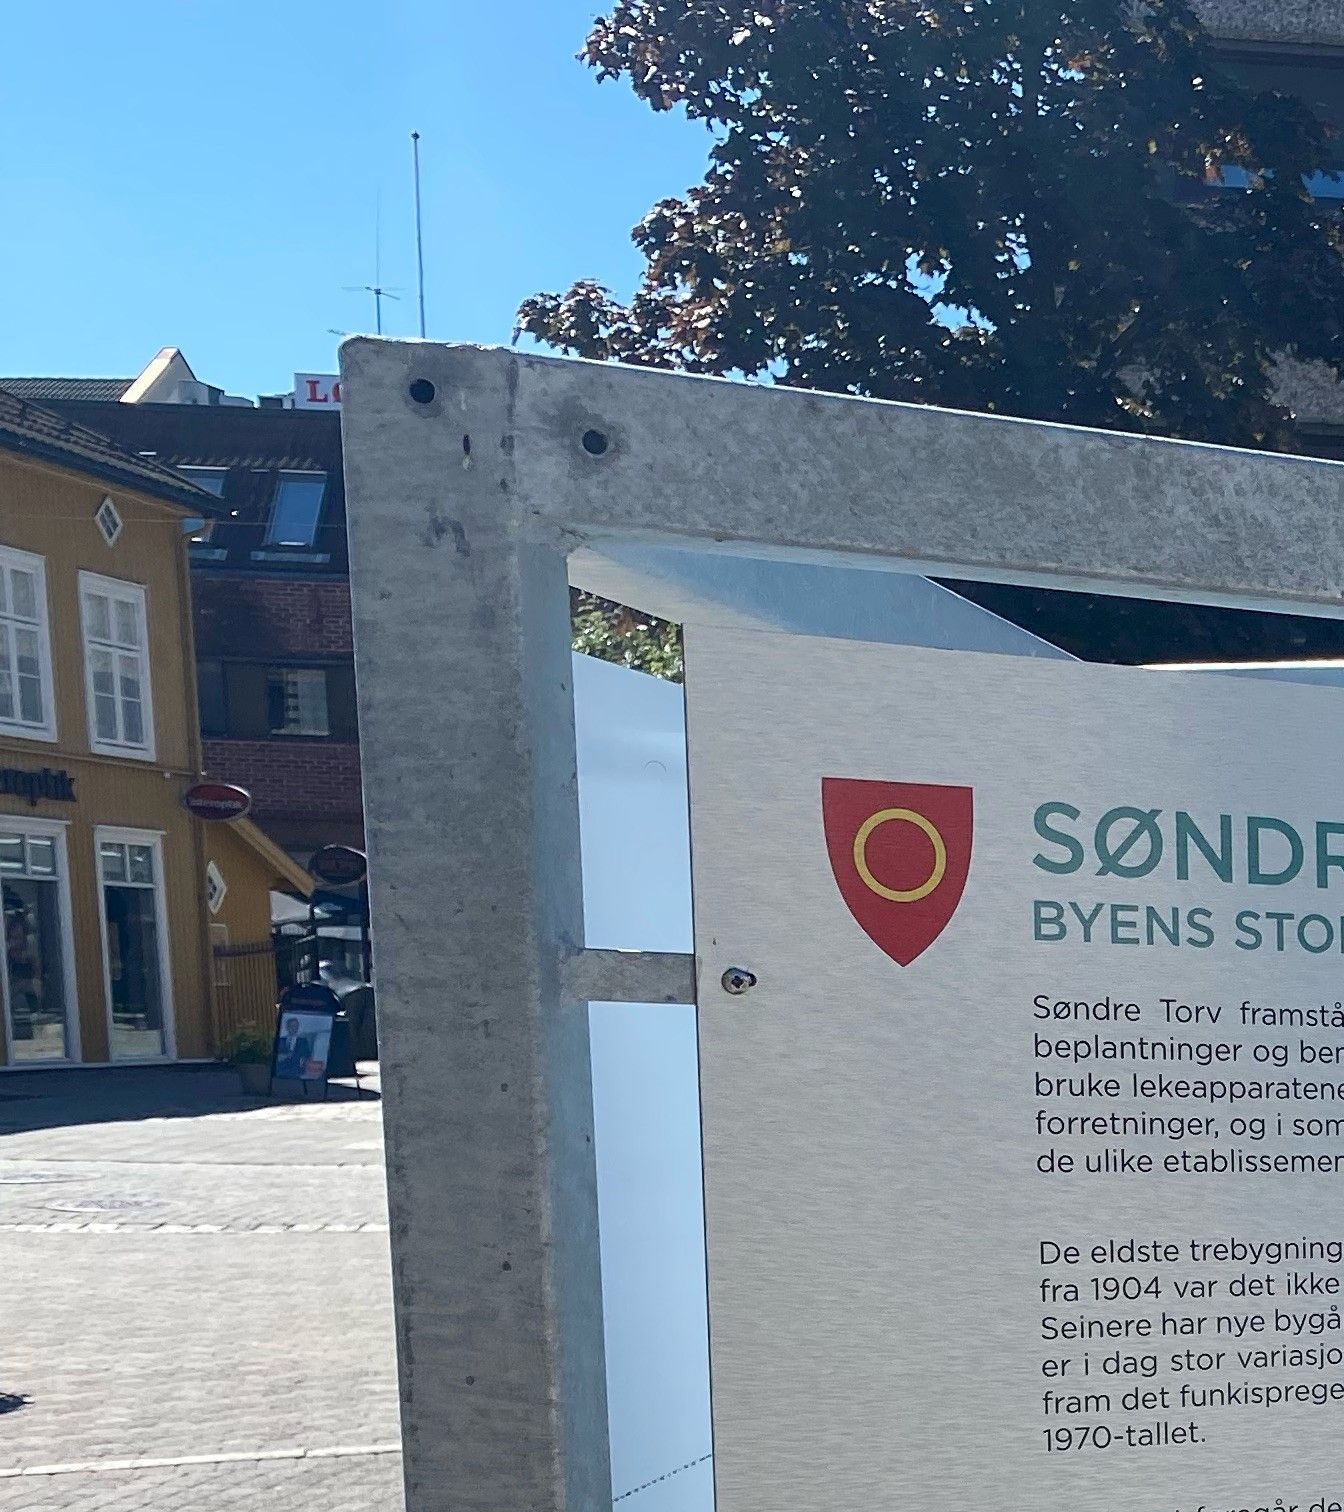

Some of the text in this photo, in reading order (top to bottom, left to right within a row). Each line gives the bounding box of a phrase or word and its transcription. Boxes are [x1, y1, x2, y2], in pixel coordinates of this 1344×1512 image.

[1034, 899, 1216, 949] BYENS
[1033, 994, 1141, 1022] Søndre
[1158, 998, 1222, 1024] Torv
[1034, 1032, 1243, 1066] beplantninger
[1252, 1044, 1289, 1068] og
[1035, 1071, 1121, 1098] bruke
[1034, 1109, 1219, 1141] forretninger,
[1229, 1117, 1266, 1141] og
[1277, 1112, 1282, 1136] i
[1036, 1148, 1075, 1174] de
[1085, 1148, 1153, 1174] ulike
[1039, 1240, 1081, 1265] De
[1090, 1238, 1180, 1264] eldste
[1039, 1277, 1079, 1303] fra
[1090, 1275, 1163, 1301] 1904
[1173, 1279, 1219, 1299] var
[1228, 1272, 1276, 1297] det
[1286, 1271, 1340, 1296] ikke
[1041, 1390, 1111, 1415] fram
[1121, 1386, 1170, 1411] det
[1042, 1420, 1206, 1453] 1970-tallet.
